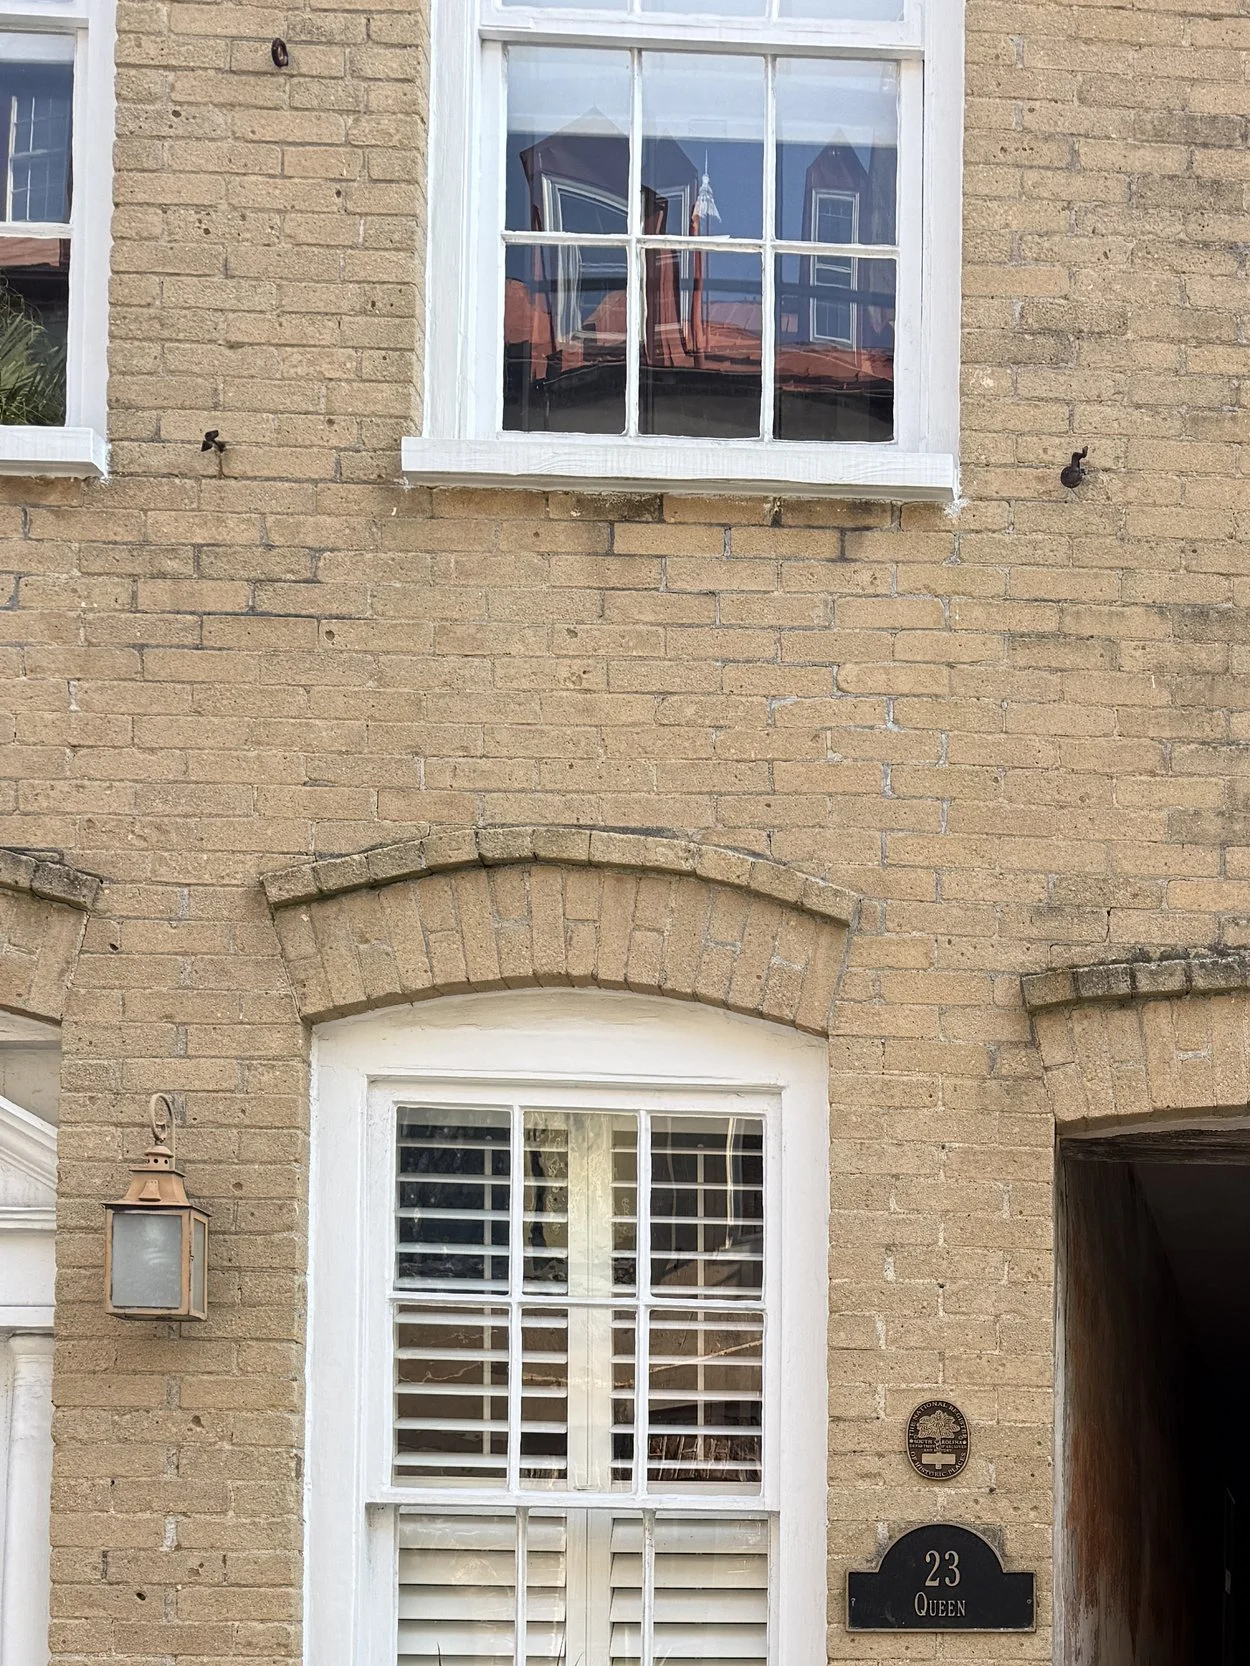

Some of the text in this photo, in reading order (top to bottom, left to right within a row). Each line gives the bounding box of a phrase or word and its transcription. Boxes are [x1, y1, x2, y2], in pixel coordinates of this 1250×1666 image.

[913, 1401, 948, 1421] NATIONAL
[948, 1405, 968, 1439] REGISTER
[910, 1451, 966, 1477] OF HISTORIC PLACES
[925, 1550, 960, 1586] 23
[914, 1591, 966, 1616] QUEEN
